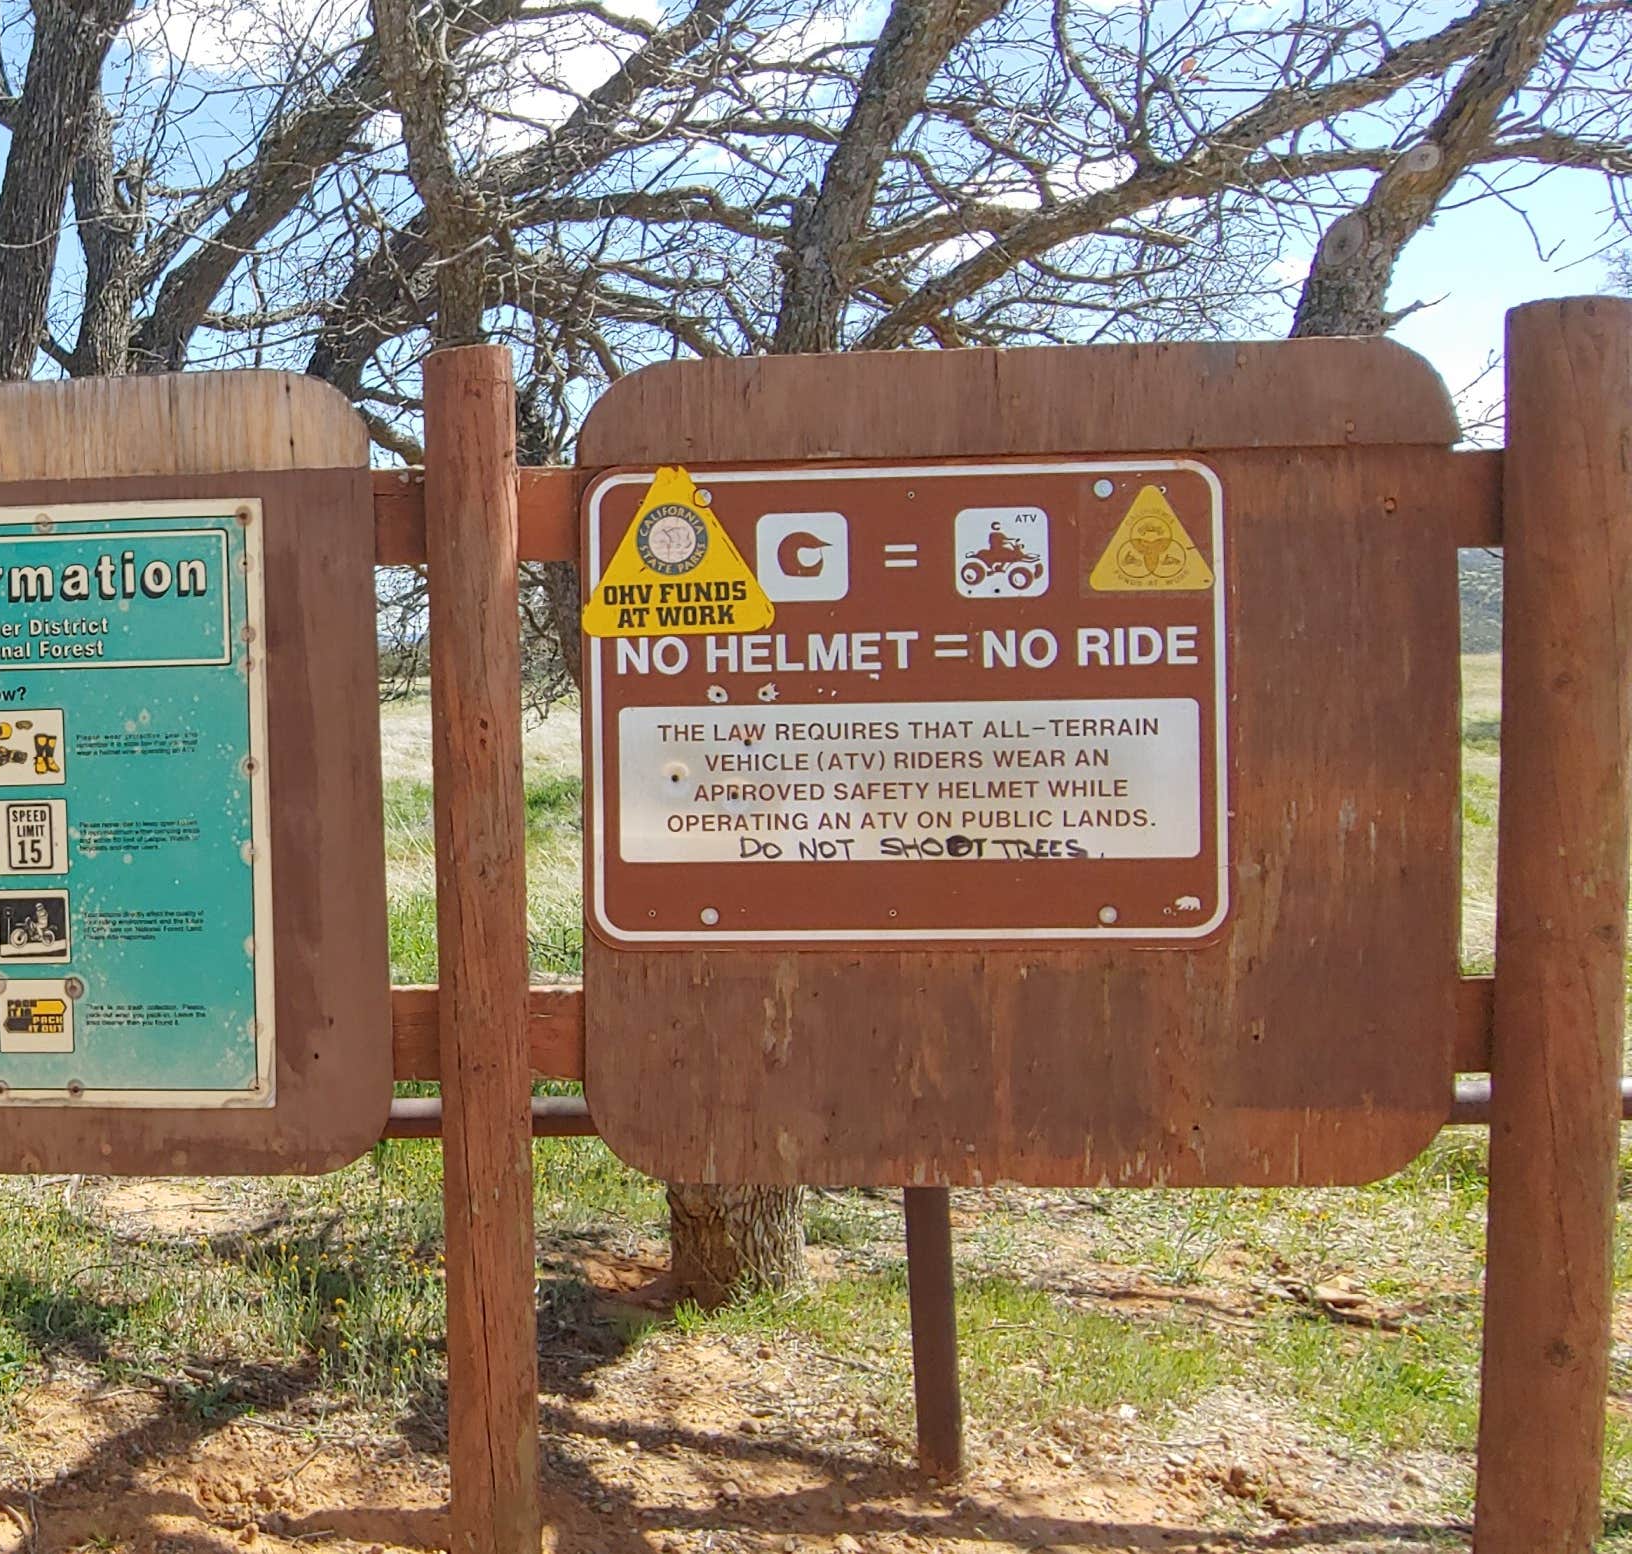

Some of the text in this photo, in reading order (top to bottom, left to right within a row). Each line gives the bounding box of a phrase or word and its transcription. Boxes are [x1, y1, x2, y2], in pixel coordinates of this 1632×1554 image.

[640, 506, 704, 537] CALIFORNIA
[1015, 514, 1037, 523] ATV
[640, 543, 705, 573] STATE PARKS
[603, 581, 746, 605] OHV FUNDS
[29, 617, 108, 636] District
[618, 605, 734, 628] AT WORK
[39, 639, 103, 658] Forest
[615, 636, 689, 675] NO
[707, 631, 918, 673] HELMET
[983, 628, 1058, 668] NO
[1076, 626, 1198, 666] RIDE
[658, 717, 1158, 741] THE LAW REQUIRES THAT ALL-TERRAIN
[706, 749, 1109, 773] VEHICLE (ATV) RIDERS WEAR AN
[694, 779, 1128, 802] APPROVED SAFETY HELMET WHILE
[12, 810, 47, 822] SPEED
[667, 809, 1156, 832] OPERATING AN ATV ON PUBLIC LANDS.
[17, 825, 45, 837] LIMIT
[18, 839, 42, 864] 15
[740, 837, 782, 859] DO
[800, 839, 855, 862] NOT
